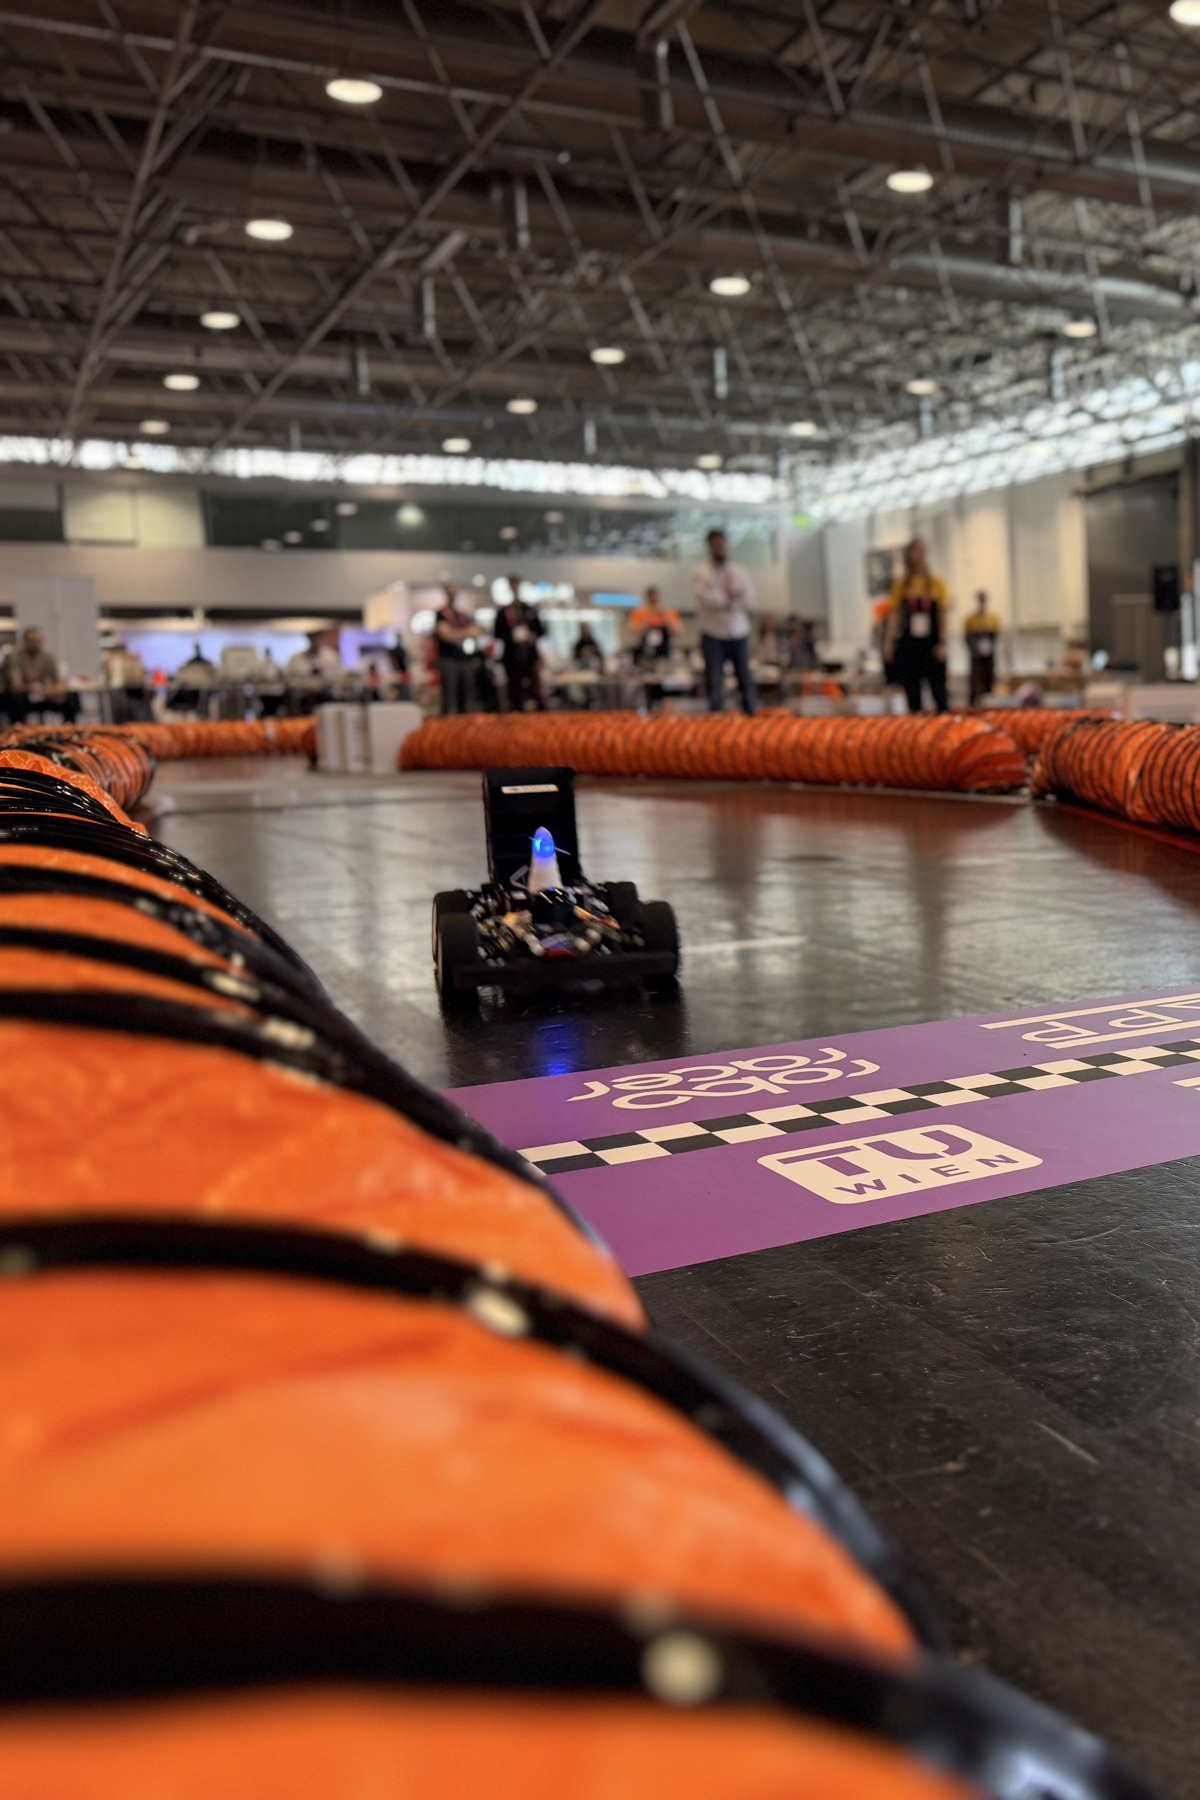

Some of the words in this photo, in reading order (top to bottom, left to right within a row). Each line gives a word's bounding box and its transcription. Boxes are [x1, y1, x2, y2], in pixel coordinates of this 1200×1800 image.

[567, 1047, 847, 1102] racer
[611, 1059, 880, 1109] robo
[776, 1130, 973, 1177] TU
[835, 1154, 1019, 1196] WIEN
